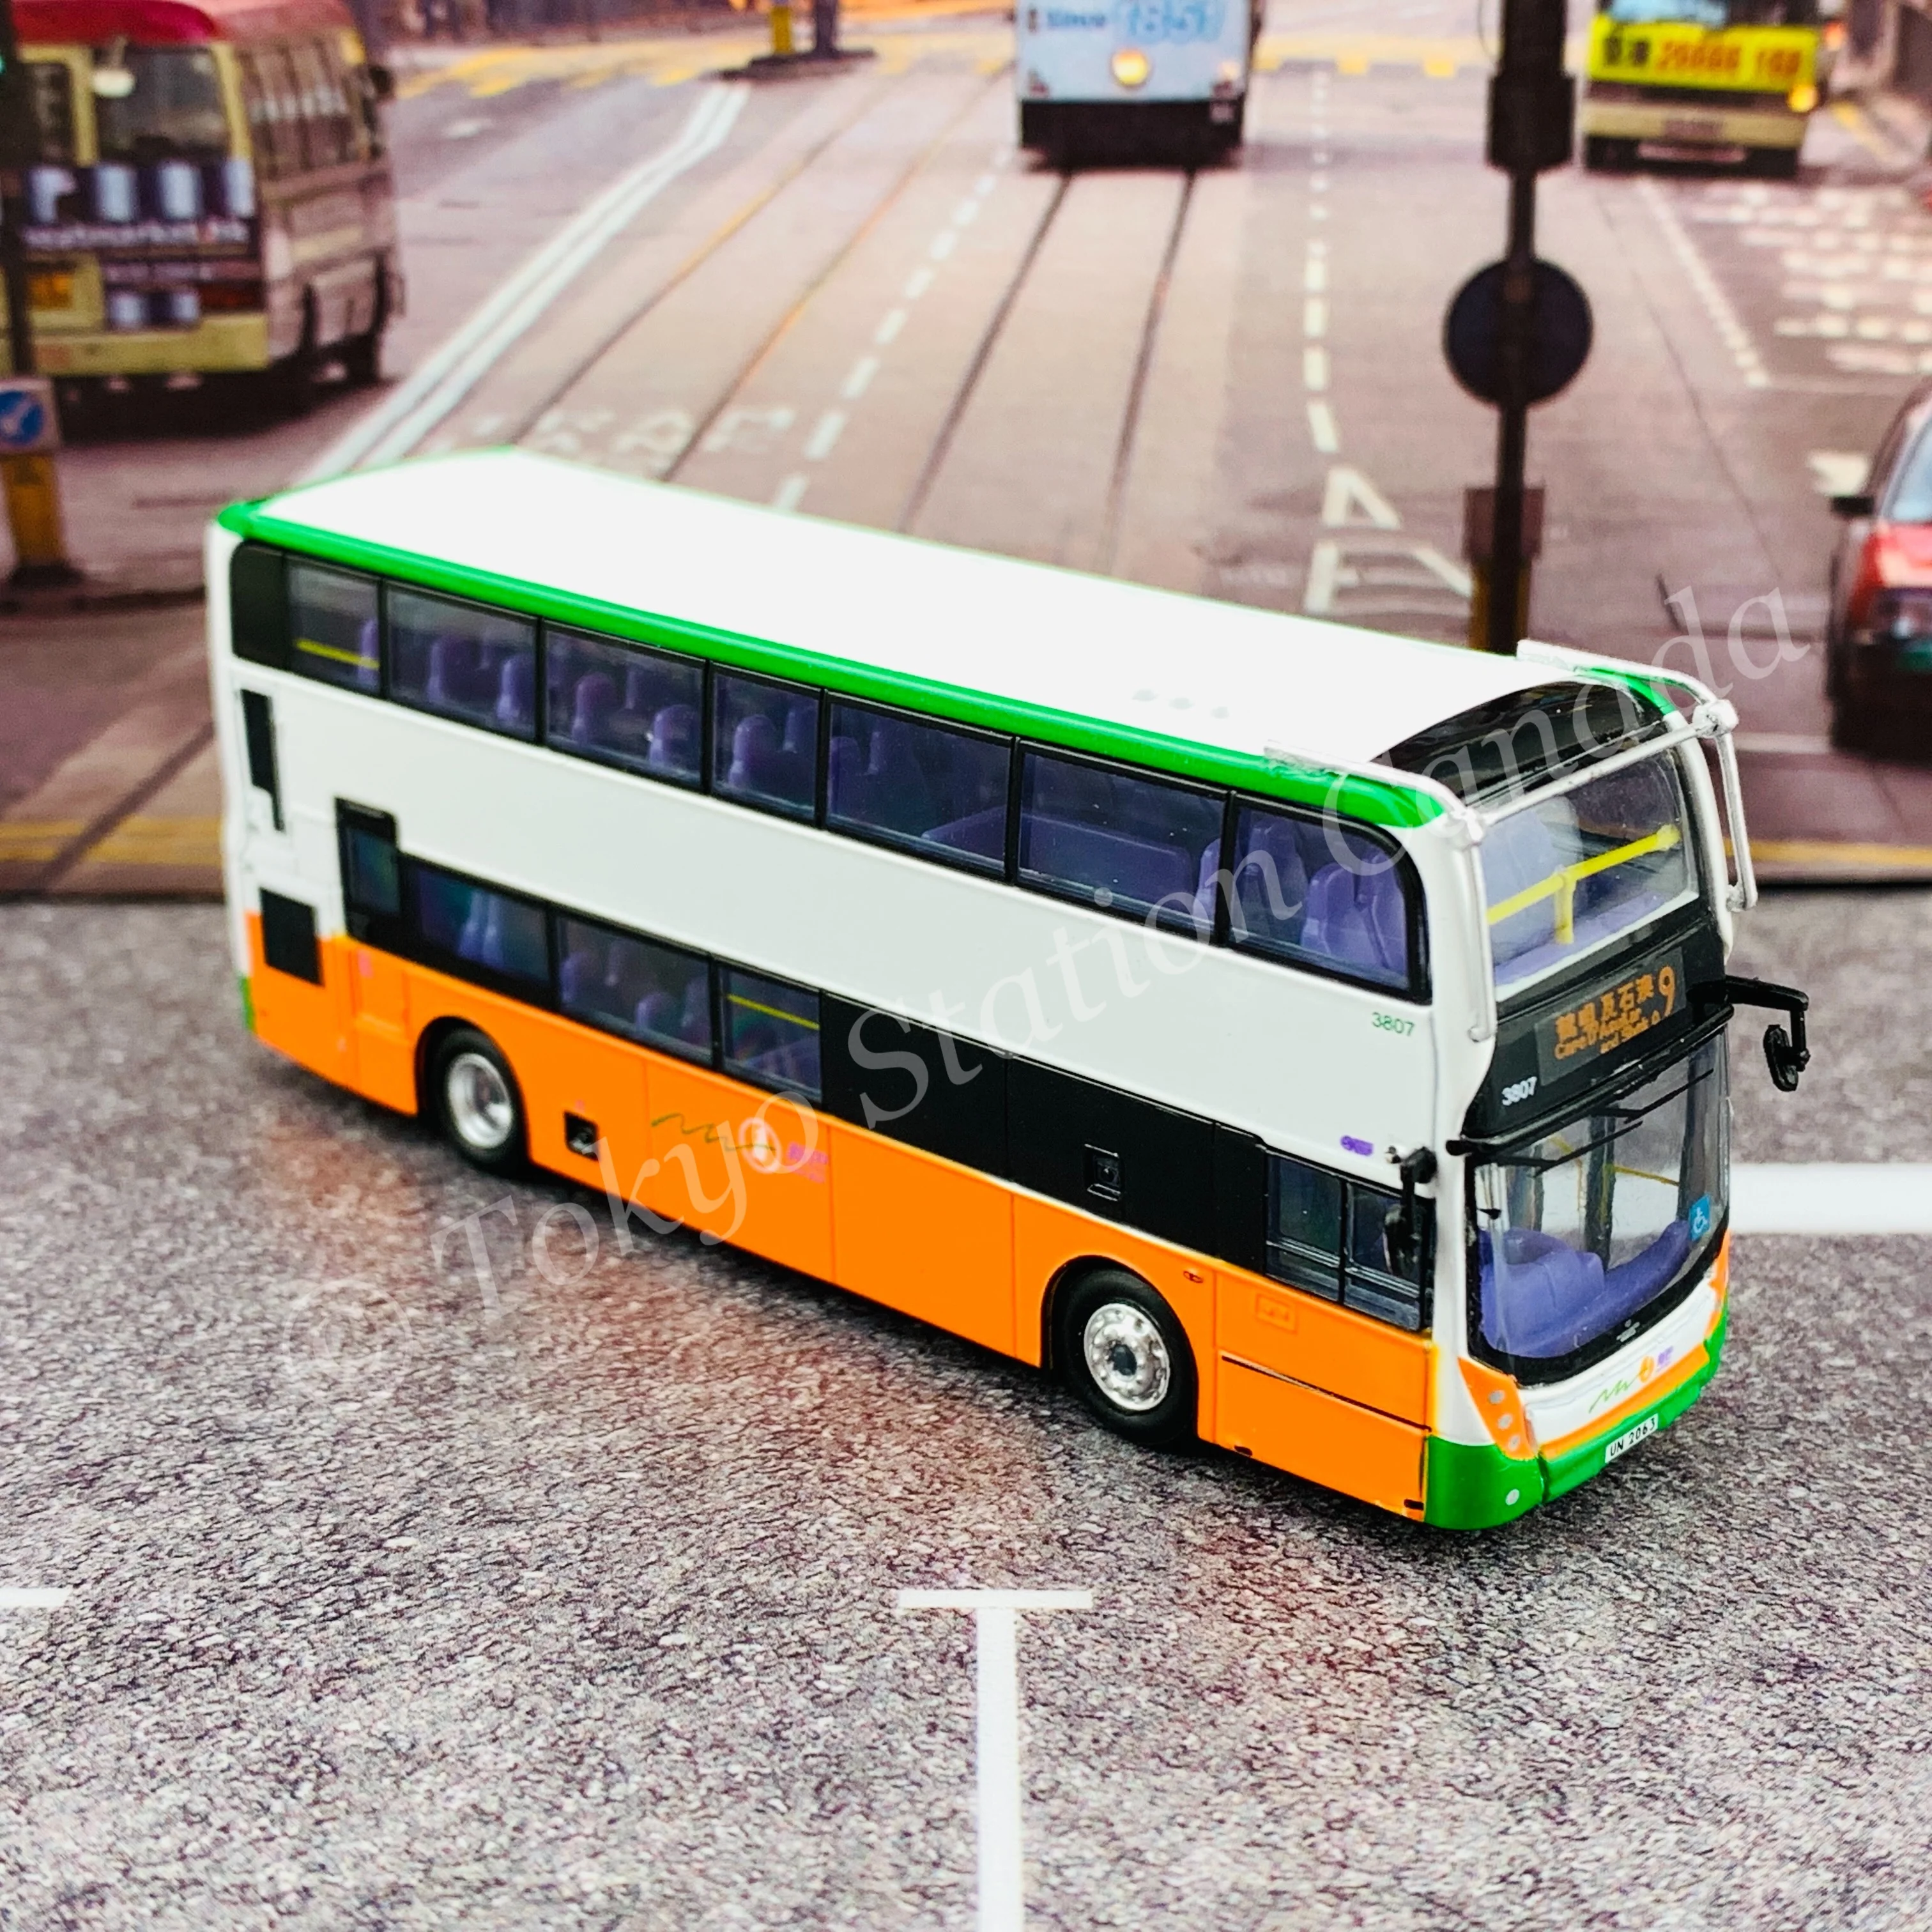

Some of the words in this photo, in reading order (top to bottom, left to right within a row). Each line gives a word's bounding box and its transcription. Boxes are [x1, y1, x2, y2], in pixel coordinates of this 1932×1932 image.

[1658, 965, 1676, 1017] 9
[1372, 1011, 1415, 1036] 3807
[1501, 1076, 1537, 1106] 3807
[1610, 1439, 1625, 1457] UN
[1628, 1416, 1657, 1445] 2063
